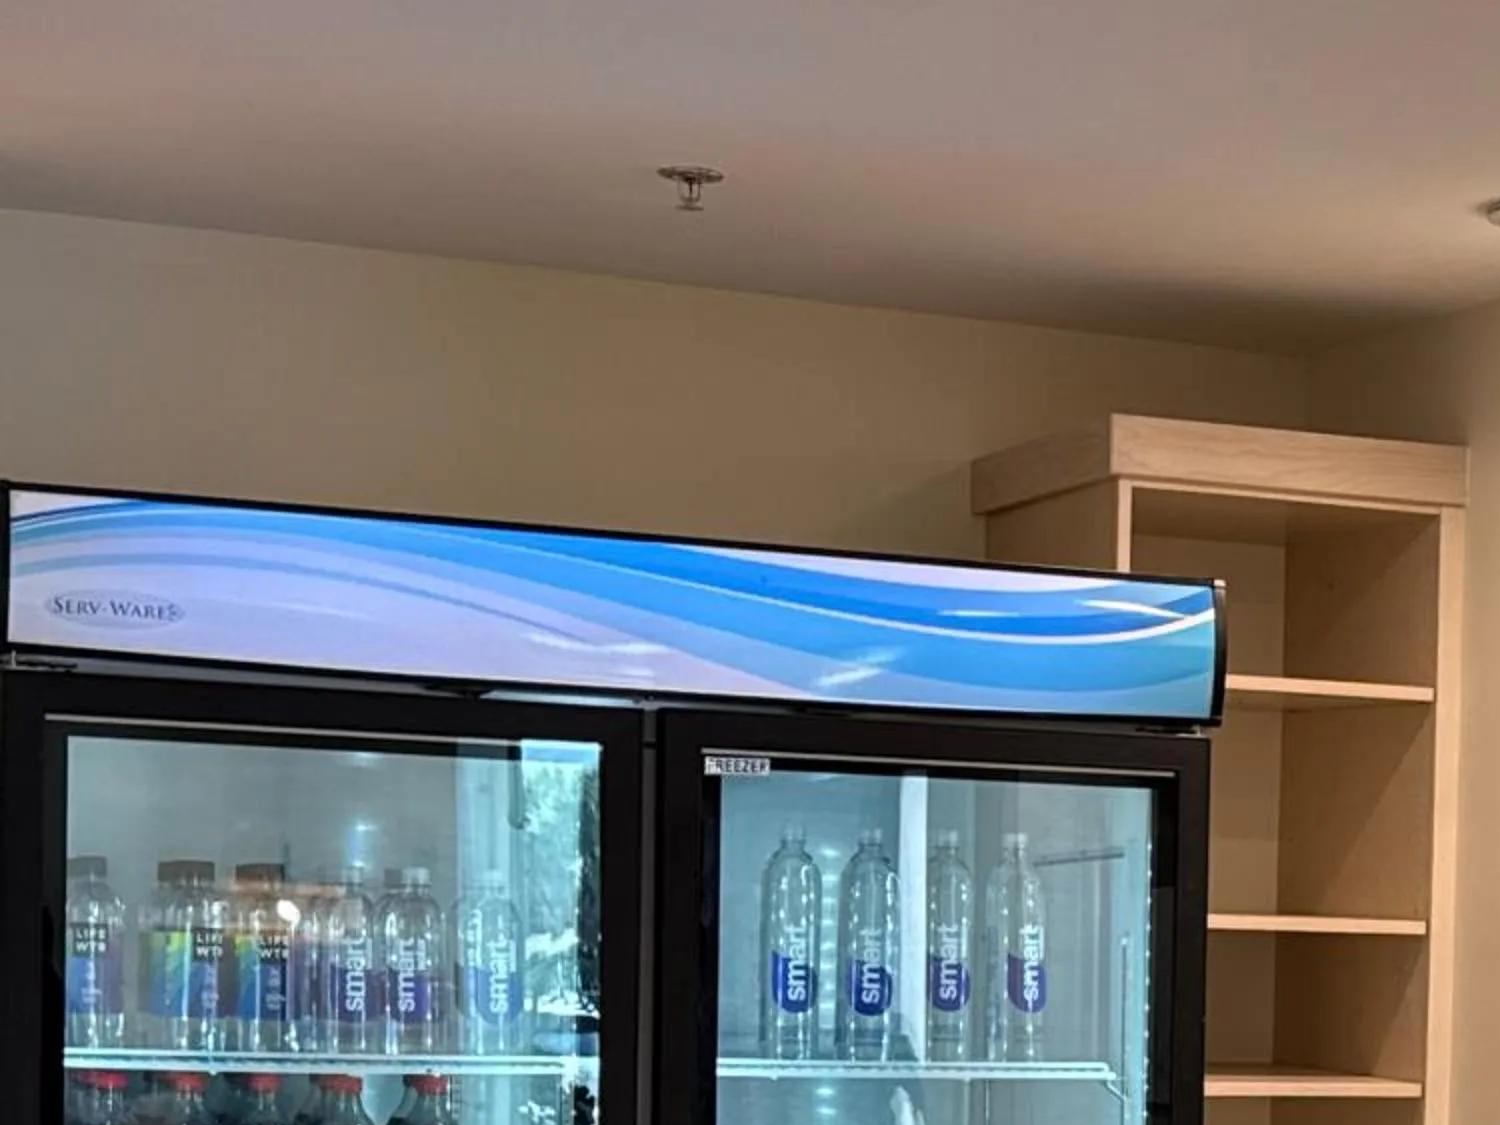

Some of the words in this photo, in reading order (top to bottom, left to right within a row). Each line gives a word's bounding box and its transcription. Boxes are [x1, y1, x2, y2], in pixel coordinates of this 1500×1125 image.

[341, 934, 366, 1012] smart
[398, 937, 416, 1012] smart
[487, 933, 509, 1013] smart
[784, 923, 806, 1002] smart
[861, 927, 882, 1004] smart
[938, 923, 959, 1002] smart
[1020, 923, 1040, 1002] smart
